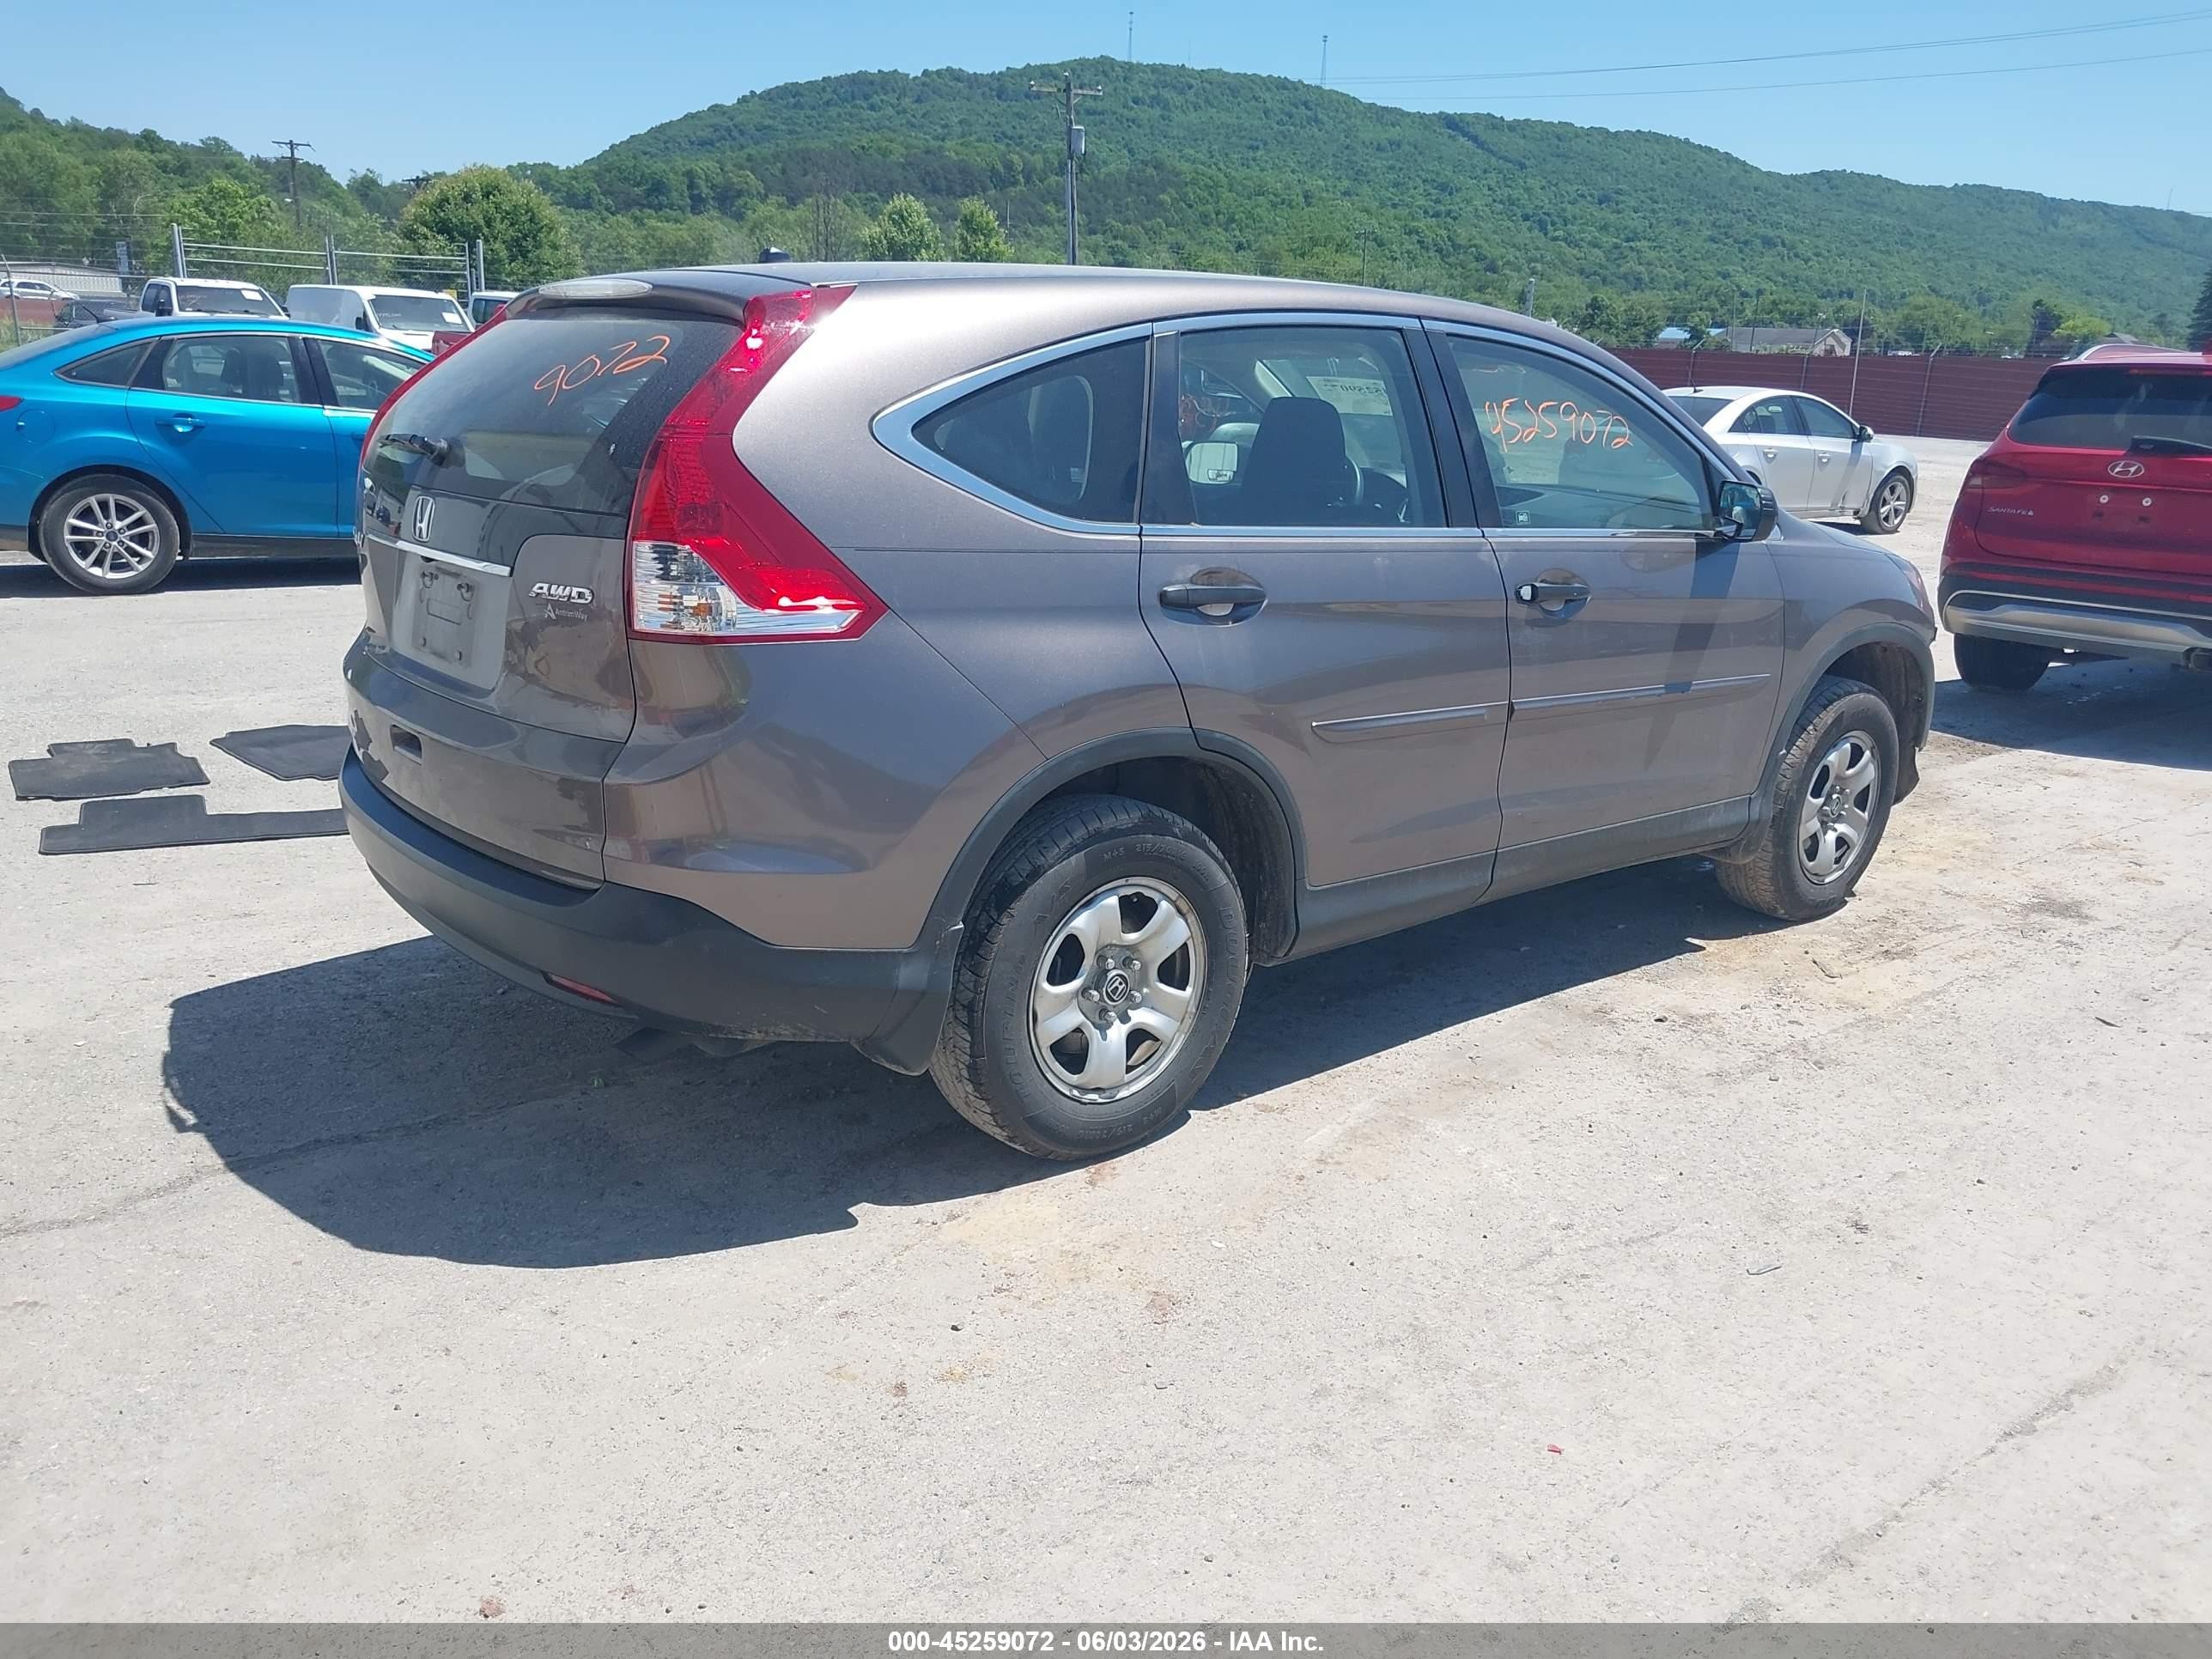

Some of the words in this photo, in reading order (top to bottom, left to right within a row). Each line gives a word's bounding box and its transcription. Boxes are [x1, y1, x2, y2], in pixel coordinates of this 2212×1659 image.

[534, 335, 671, 406] 9072
[1485, 398, 1634, 453] 45259072
[528, 582, 593, 605] AWD
